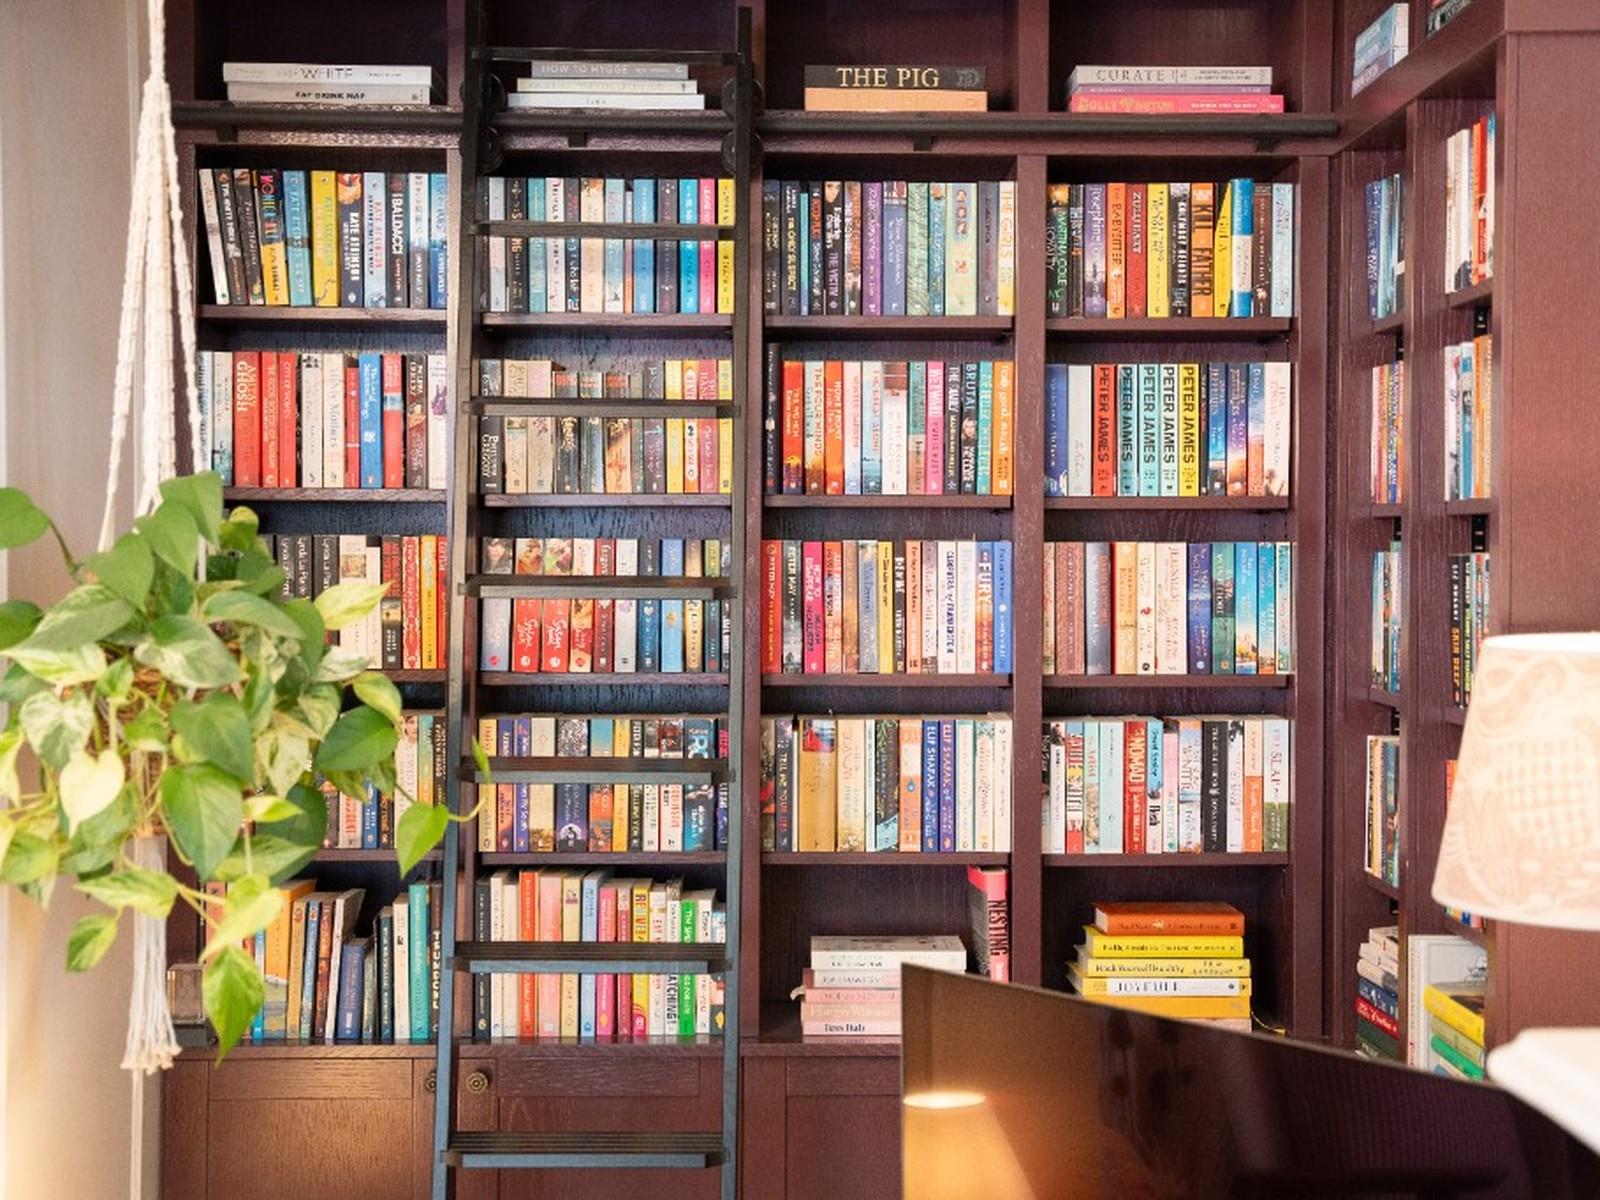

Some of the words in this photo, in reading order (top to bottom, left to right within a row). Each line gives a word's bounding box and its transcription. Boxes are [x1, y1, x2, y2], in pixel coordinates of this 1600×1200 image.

[542, 64, 569, 74] HOW
[573, 65, 588, 74] TO
[591, 65, 628, 75] HYGGE
[836, 68, 888, 88] THE
[897, 68, 940, 88] PIG
[1096, 68, 1165, 82] CURATE
[1001, 191, 1012, 215] THE
[1132, 192, 1141, 223] ZULU
[1192, 204, 1213, 233] KILL
[349, 212, 359, 234] KATE
[392, 198, 403, 254] BALDACCI
[1001, 218, 1012, 257] GIRLS
[1058, 211, 1066, 256] MARTINA
[1112, 203, 1122, 265] BABYSITTER
[350, 236, 359, 281] ATKINSON
[788, 254, 796, 291] SUSPECT
[829, 253, 838, 268] THE
[1058, 258, 1067, 286] COLE
[1178, 250, 1187, 284] HEIGHTS
[1192, 248, 1213, 296] FATHER
[829, 269, 838, 296] VICTIM
[237, 361, 247, 411] GHOSH
[247, 365, 256, 407] AMITAV
[814, 368, 822, 387] THE
[949, 367, 960, 383] THE
[965, 363, 976, 412] BRUTAL
[1098, 367, 1109, 413] PETER
[1122, 366, 1132, 412] PETER
[1143, 366, 1155, 413] PETER
[1163, 366, 1175, 413] PETER
[1183, 366, 1194, 413] PETER
[814, 390, 822, 418] FOUR
[949, 384, 960, 413] FAMILY
[814, 419, 822, 456] WINDS
[1098, 416, 1109, 463] JAMES
[1122, 416, 1132, 462] JAMES
[1143, 416, 1155, 464] JAMES
[1163, 416, 1175, 463] JAMES
[1183, 416, 1195, 464] JAMES
[297, 537, 307, 559] Lynda
[298, 560, 306, 570] La
[322, 538, 331, 561] Lynda
[788, 547, 796, 575] PETER
[324, 562, 331, 570] La
[978, 562, 991, 603] FURY
[1452, 564, 1460, 580] LIZ
[788, 577, 796, 596] MAY
[1452, 583, 1460, 621] NUGENT
[946, 603, 954, 654] FRANKENSTEIN
[1452, 628, 1460, 654] SKIN
[1452, 657, 1461, 688] DEEP
[927, 726, 935, 744] ELIF
[943, 724, 951, 742] ELIF
[780, 753, 788, 772] TELL
[927, 748, 935, 787] SHAFAK
[1128, 736, 1144, 782] NOMAD
[1270, 751, 1282, 785] SLAP
[988, 900, 1010, 957] NESTING
